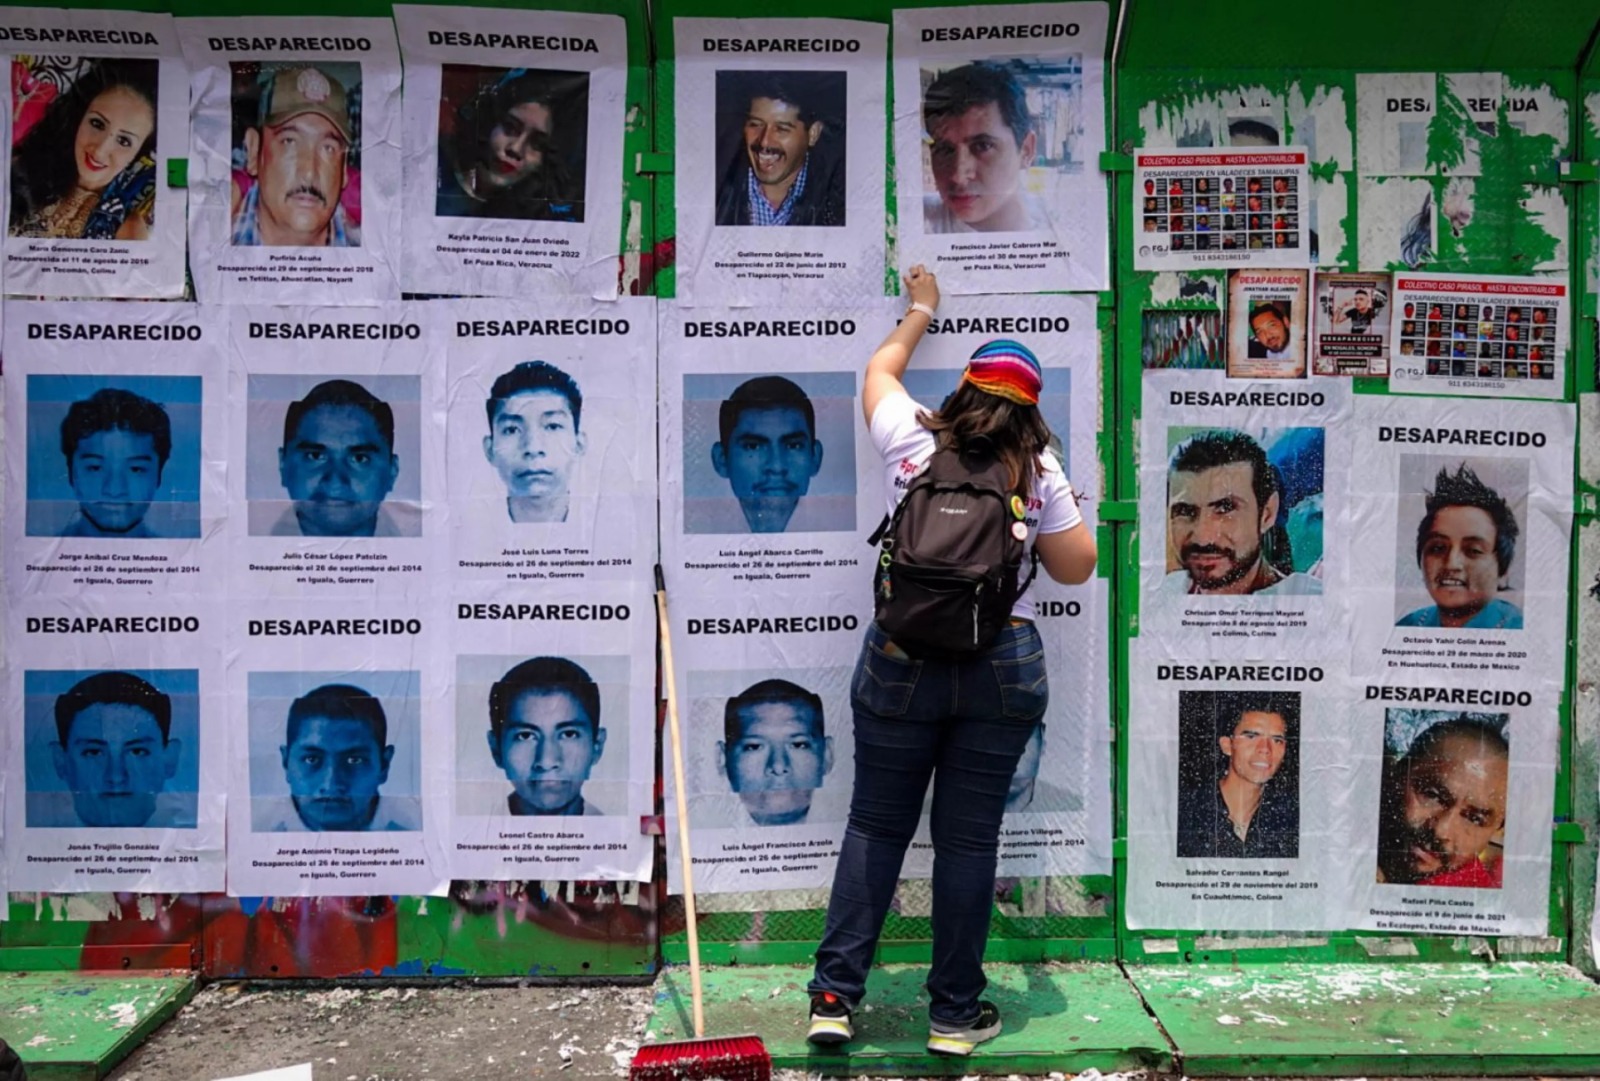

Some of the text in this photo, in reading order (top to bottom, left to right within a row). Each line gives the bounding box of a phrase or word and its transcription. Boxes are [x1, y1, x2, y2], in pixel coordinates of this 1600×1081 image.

[0, 28, 159, 46] DESAPARECIDA
[921, 23, 1080, 42] DESAPARECIDO
[208, 37, 372, 51] DESAPARECIDO
[428, 31, 599, 52] DESAPARECIDA
[703, 38, 860, 52] DESAPARECIDO
[1143, 157, 1175, 165] COLECTIVO
[1178, 157, 1194, 165] CASO
[1226, 156, 1245, 164] HASTA
[1247, 155, 1296, 163] ENCONTRARLOS
[437, 246, 491, 255] Desaparecida
[1240, 276, 1301, 284] DESAPARECIDO
[1404, 282, 1557, 294] COLECTIVO CASO PIRASOL HASTA ENCONTRARLOS
[1404, 294, 1464, 303] DESAPARECIERON
[28, 323, 202, 341] DESAPARECIDO
[249, 322, 420, 340] DESAPARECIDO
[456, 319, 630, 337] DESAPARECIDO
[684, 320, 856, 337] DESAPARECIDO
[896, 317, 1070, 334] SAPARECIDO
[1170, 391, 1325, 407] DESAPARECIDO
[1378, 427, 1546, 447] DESAPARECIDO
[459, 560, 514, 568] Desaparecido
[685, 562, 741, 570] Desaparecido
[458, 604, 631, 620] DESAPARECIDO
[26, 616, 199, 633] DESAPARECIDO
[248, 619, 421, 636] DESAPARECIDO
[687, 615, 858, 634] DESAPARECIDO
[1157, 666, 1324, 682] DESAPARECIDO
[1366, 685, 1532, 706] DESAPARECIDO
